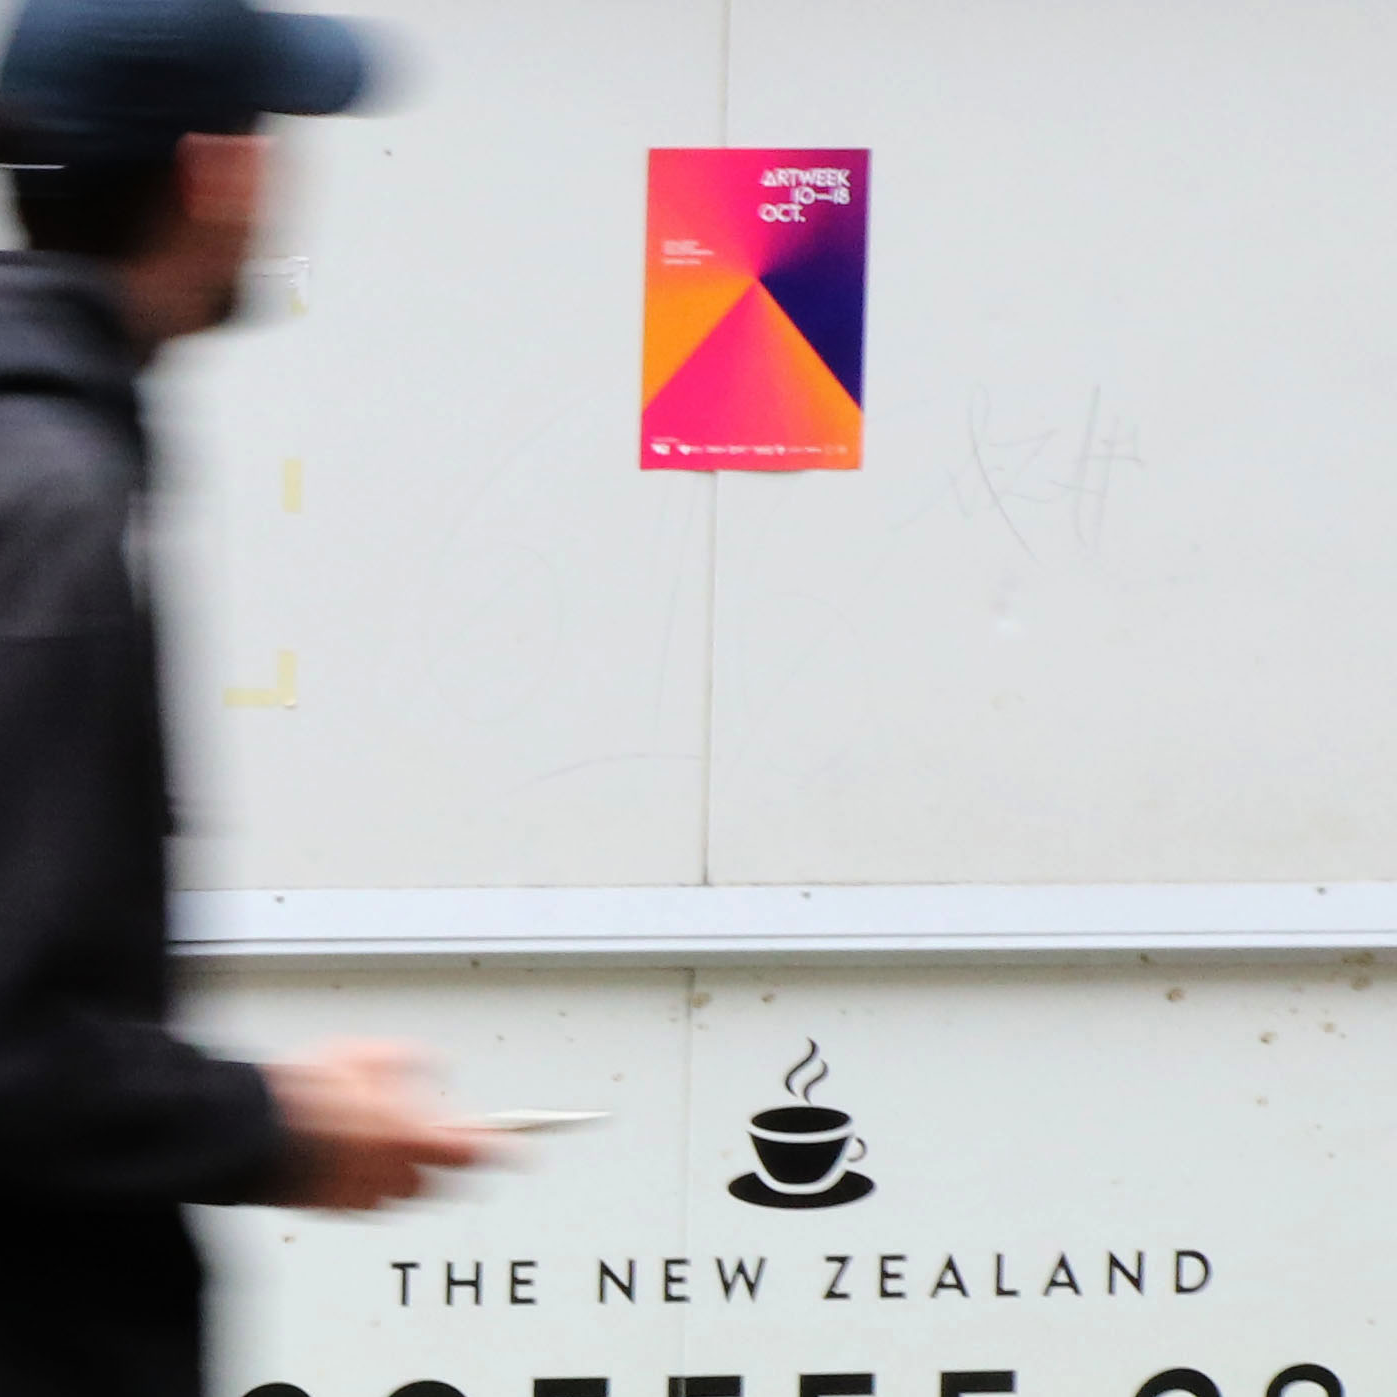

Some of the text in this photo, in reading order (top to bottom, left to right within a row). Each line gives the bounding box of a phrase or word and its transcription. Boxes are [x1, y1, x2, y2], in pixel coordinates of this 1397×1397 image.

[760, 167, 851, 187] ARTWEEK
[390, 1248, 1213, 1306] THE NEW ZEALAND
